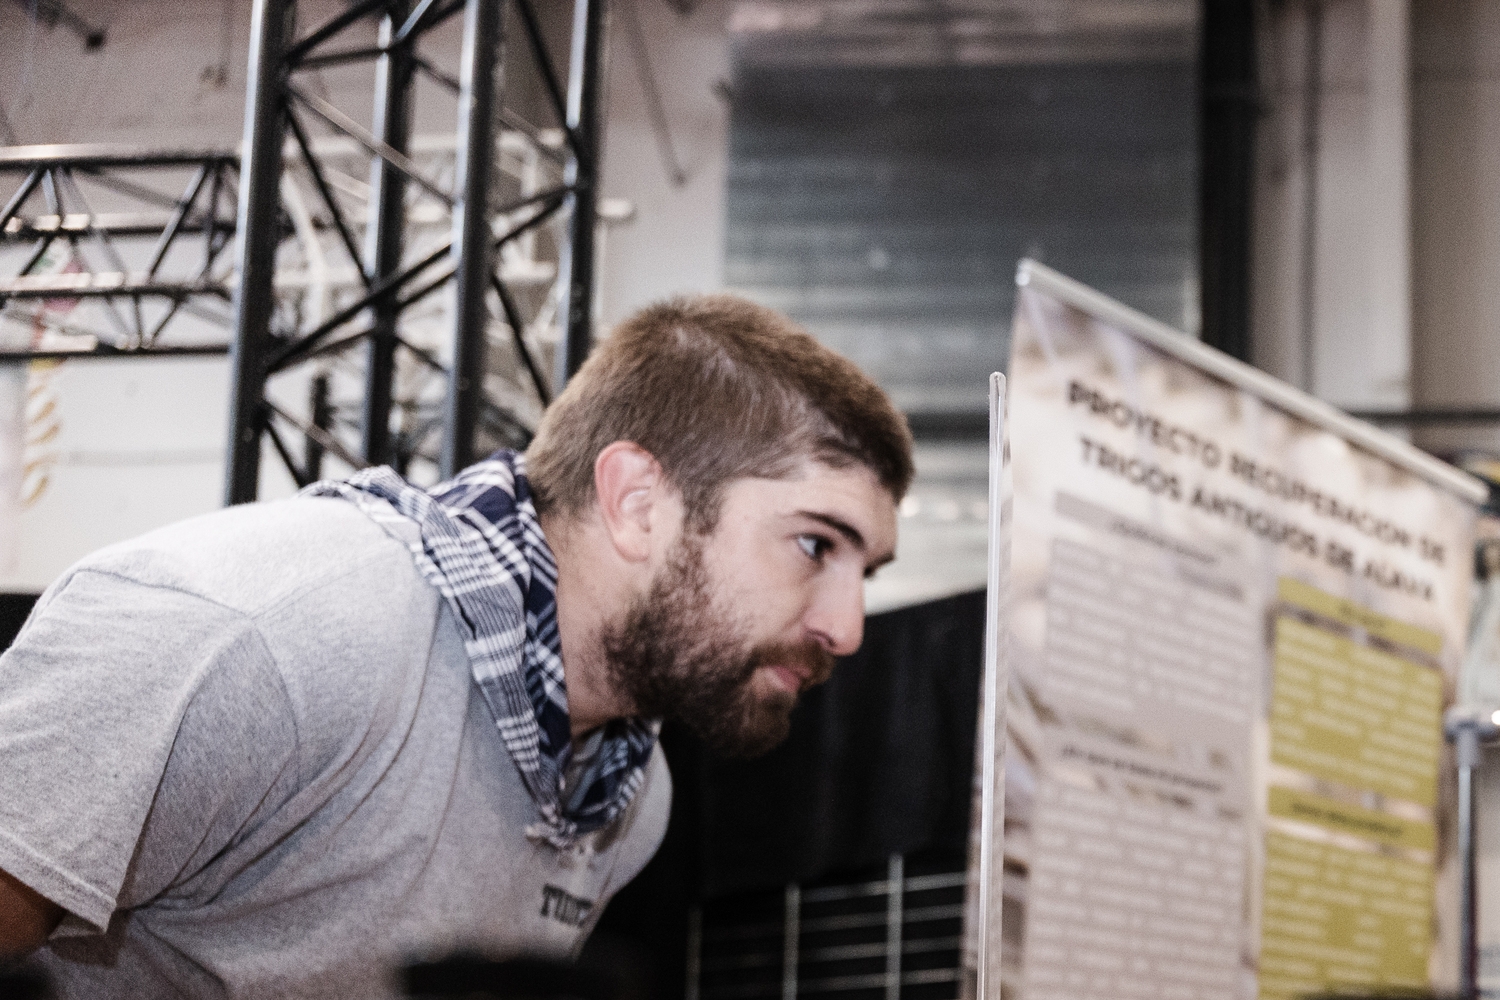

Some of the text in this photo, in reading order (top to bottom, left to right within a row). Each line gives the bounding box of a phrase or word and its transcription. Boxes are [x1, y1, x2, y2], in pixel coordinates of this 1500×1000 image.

[1068, 378, 1222, 471] PROYECTO
[1418, 533, 1446, 569] DE
[1081, 432, 1181, 502] TRIGOS
[1189, 484, 1318, 559] ANTIGUOS
[1324, 540, 1355, 577] DE
